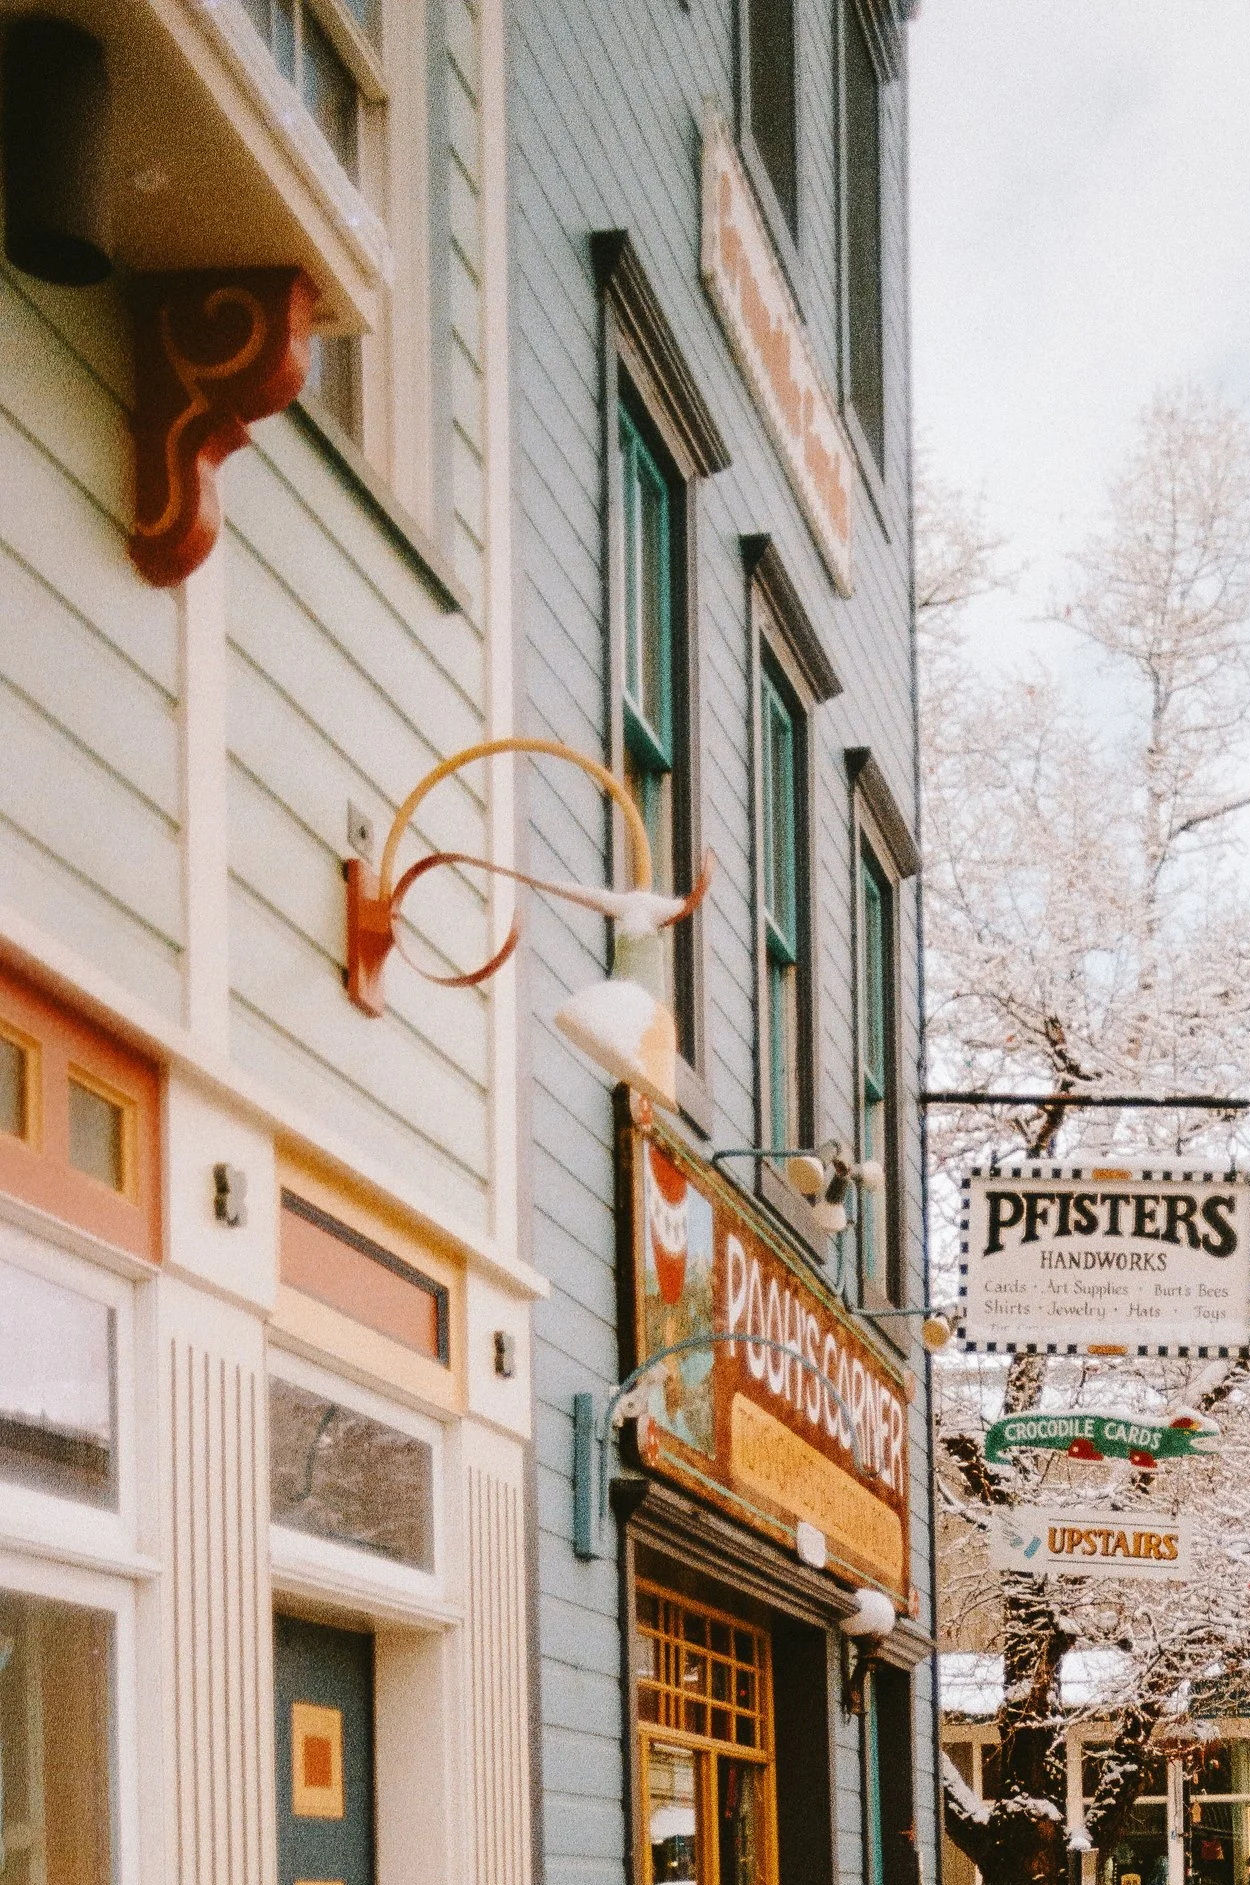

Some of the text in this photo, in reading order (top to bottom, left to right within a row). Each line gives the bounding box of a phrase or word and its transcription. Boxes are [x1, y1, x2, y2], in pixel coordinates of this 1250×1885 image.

[983, 1191, 1238, 1259] PFISTERS
[1040, 1251, 1168, 1272] HANDWORKS
[984, 1279, 1229, 1298] Cards Art Supplies Burt's Bees
[984, 1299, 1227, 1322] Shirts Jewelry Hats Toys
[727, 1233, 820, 1426] POOH'S
[823, 1333, 904, 1496] CORNER
[1004, 1418, 1163, 1449] CROCODILE CARDS
[1047, 1526, 1179, 1560] UPSTAIRS
